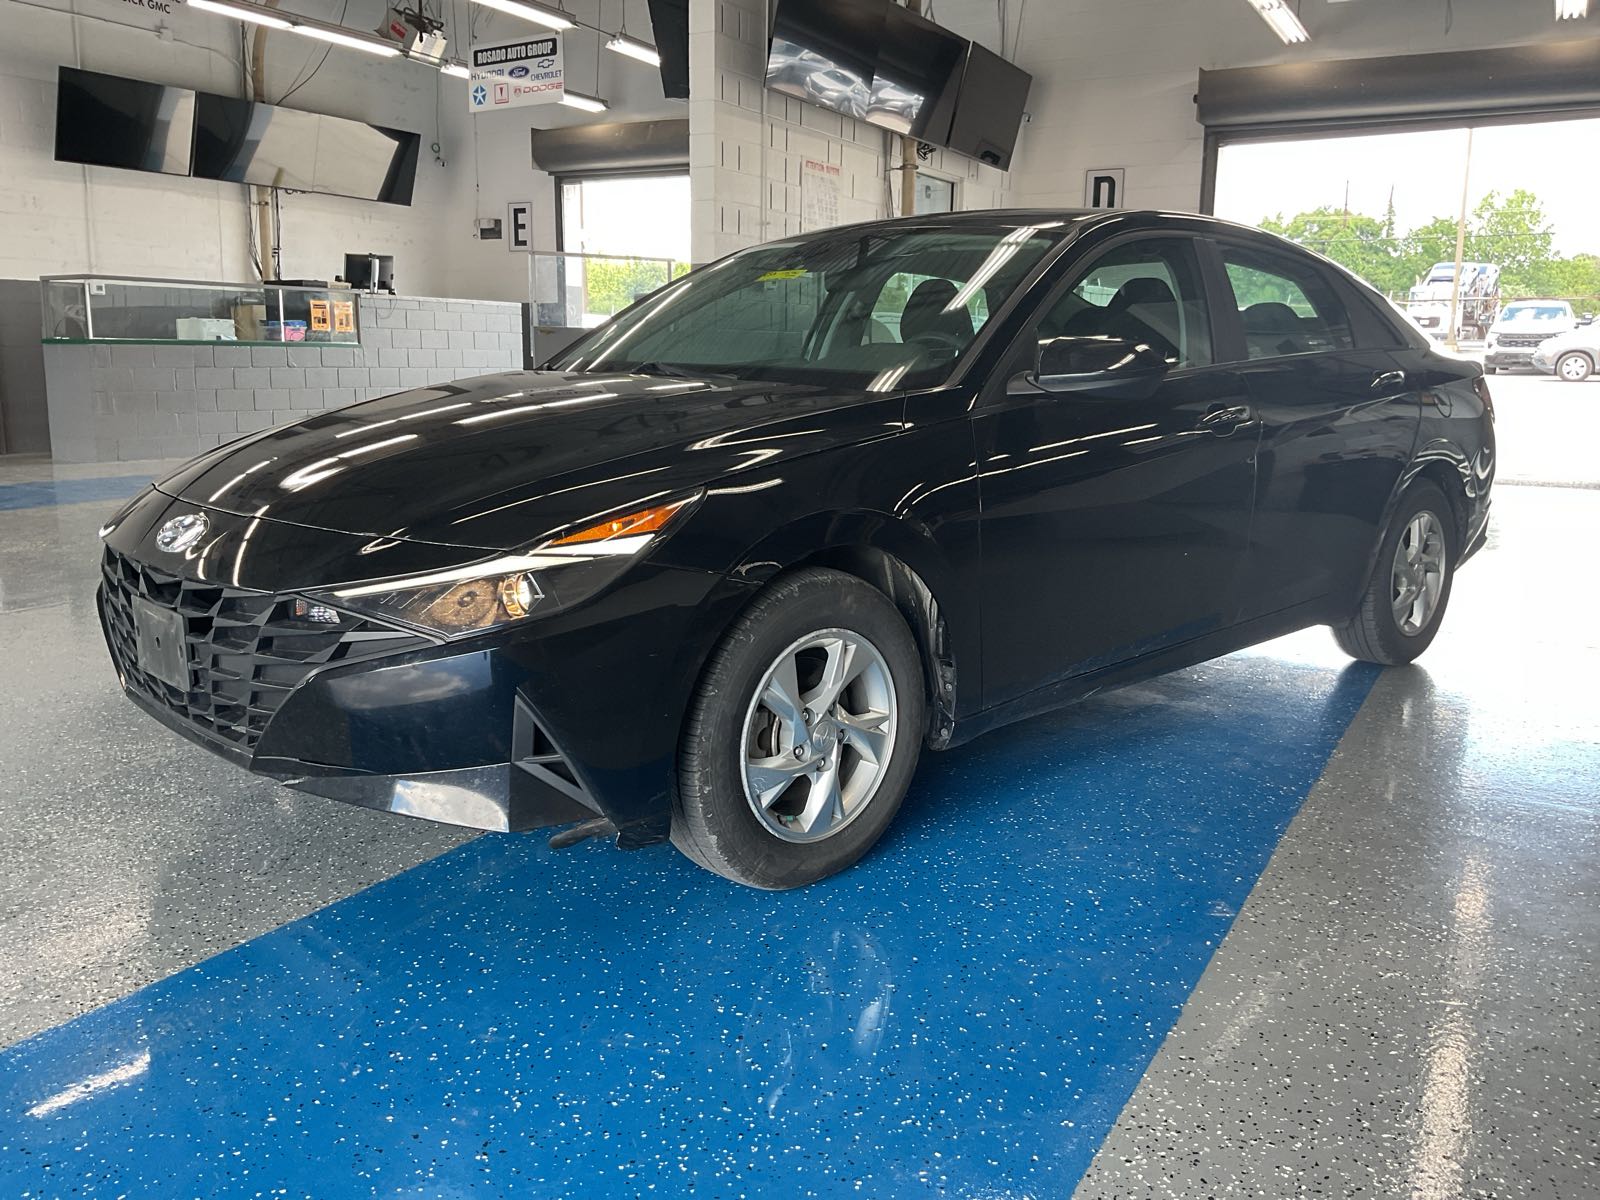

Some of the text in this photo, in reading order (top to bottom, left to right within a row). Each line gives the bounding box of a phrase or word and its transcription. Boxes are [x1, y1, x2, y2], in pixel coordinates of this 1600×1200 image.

[148, 0, 170, 14] GMC
[477, 41, 553, 64] ROSADO AUTO GROUP
[471, 69, 505, 81] HYUNDAI
[511, 67, 527, 78] Ford
[531, 70, 562, 81] CHEVROLET
[523, 82, 563, 94] DODGE
[513, 208, 527, 246] E
